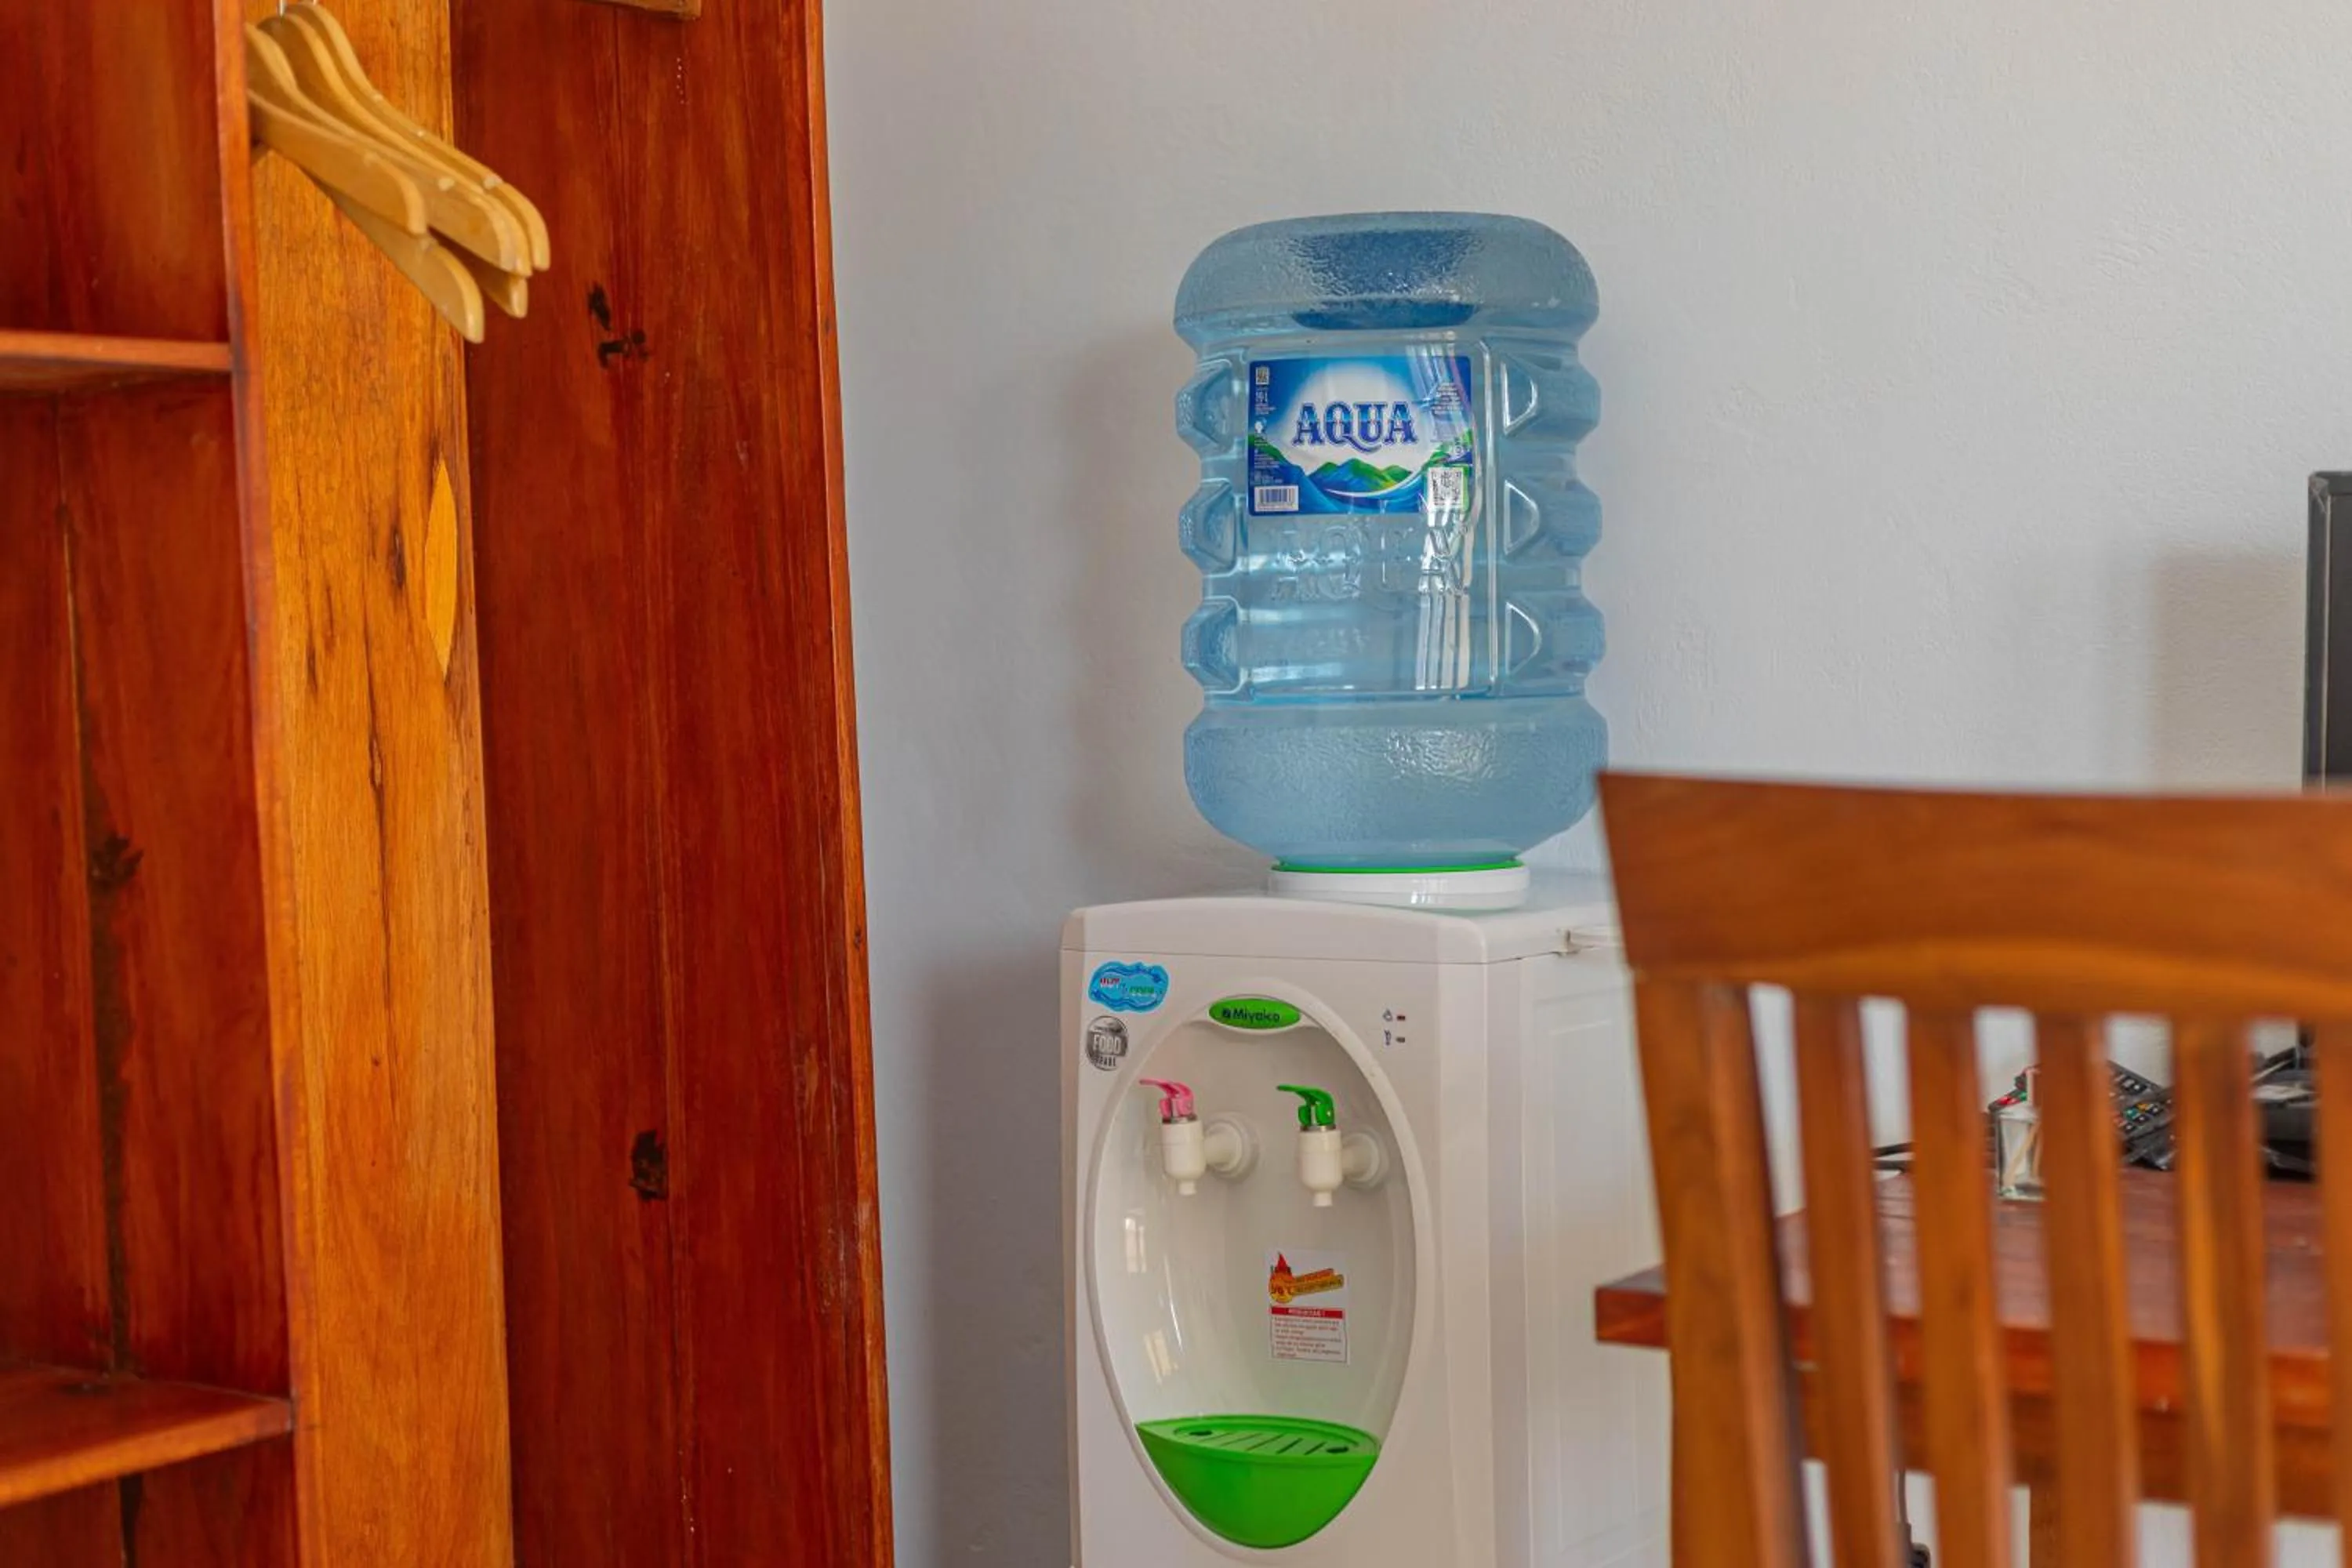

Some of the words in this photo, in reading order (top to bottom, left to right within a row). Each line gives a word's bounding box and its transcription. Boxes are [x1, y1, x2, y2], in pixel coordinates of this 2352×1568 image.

[1293, 401, 1419, 452] AQUA
[1233, 1007, 1280, 1024] Miyako
[1093, 1033, 1122, 1054] FOOD
